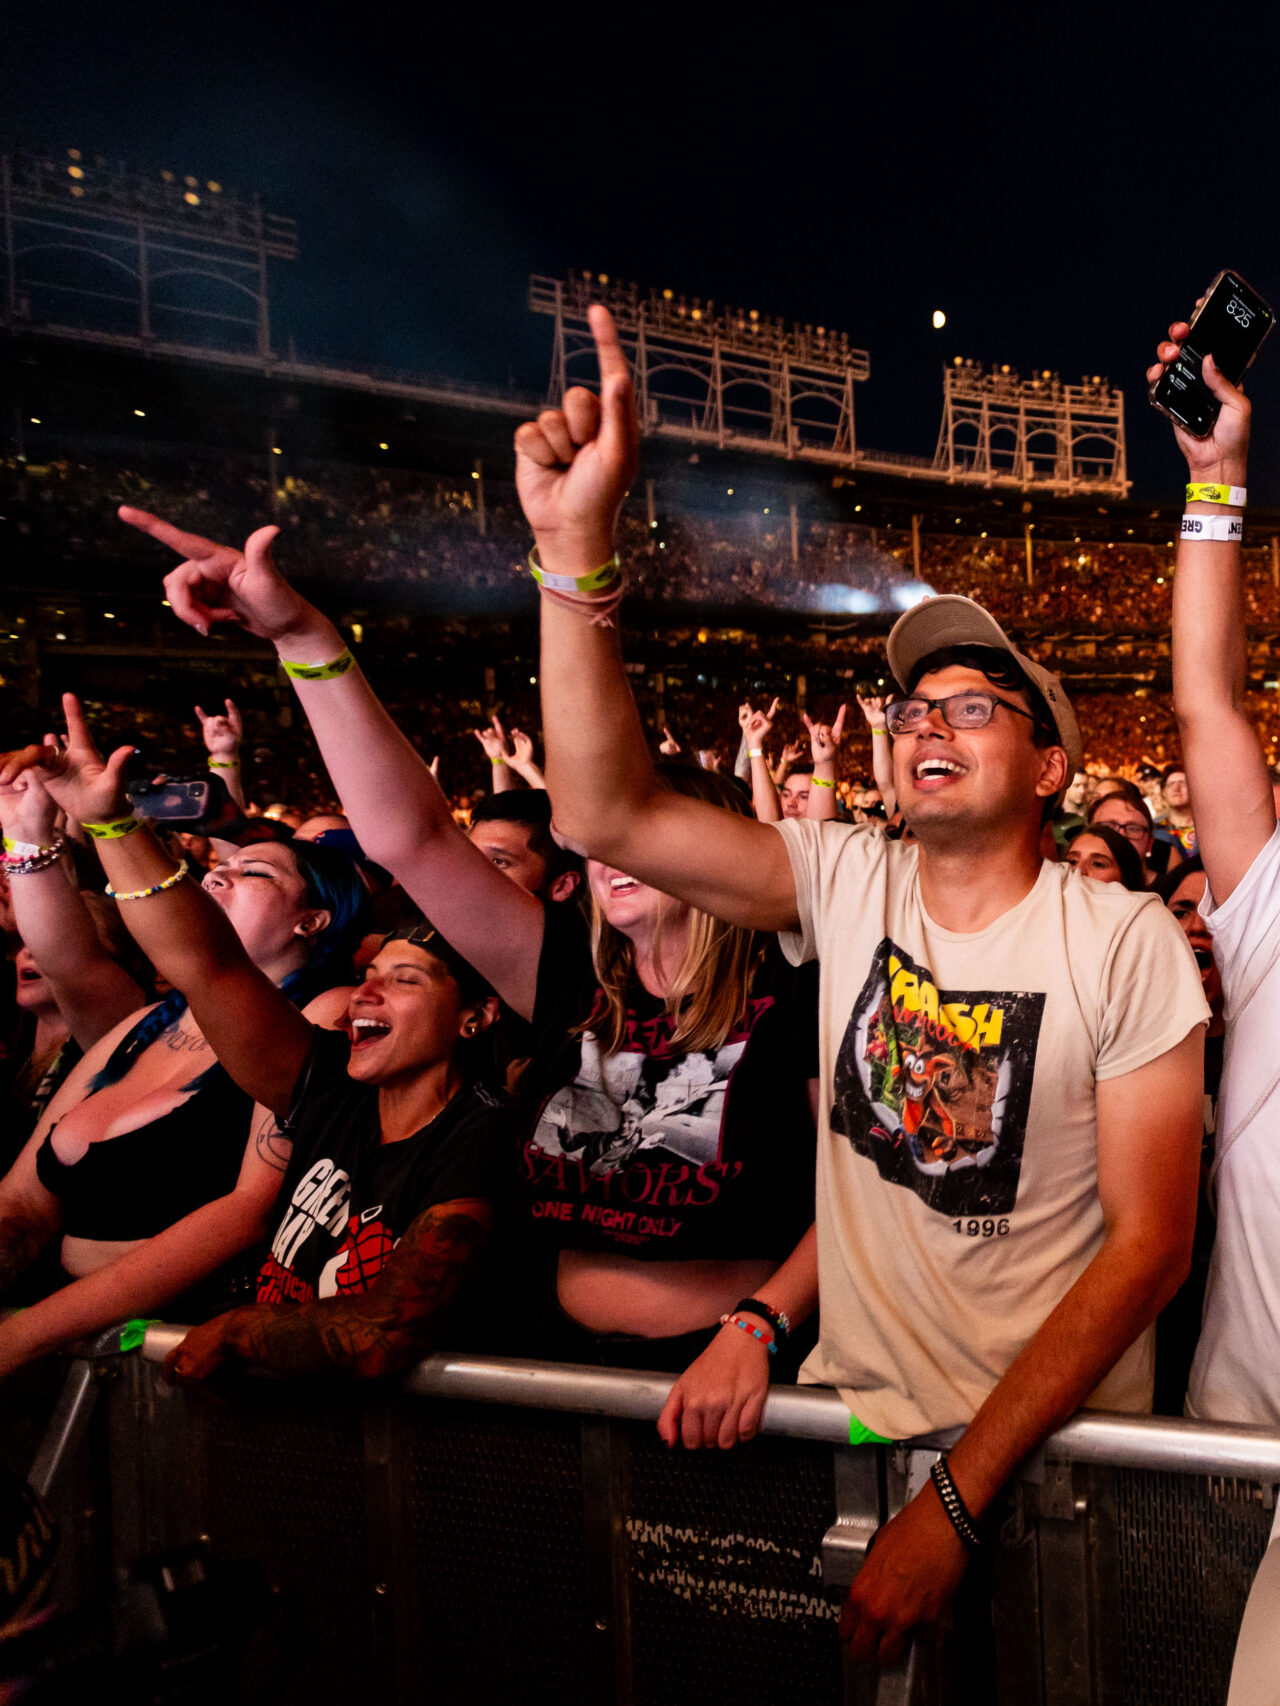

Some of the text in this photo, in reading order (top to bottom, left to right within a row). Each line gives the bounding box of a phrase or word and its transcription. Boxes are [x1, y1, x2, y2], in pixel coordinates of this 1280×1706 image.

[1226, 299, 1250, 328] 8:25
[889, 955, 1005, 1054] RASH
[532, 1201, 574, 1221] ONE
[581, 1203, 637, 1230] NIGHT
[637, 1215, 684, 1238] ONLY
[952, 1217, 1010, 1238] 1996
